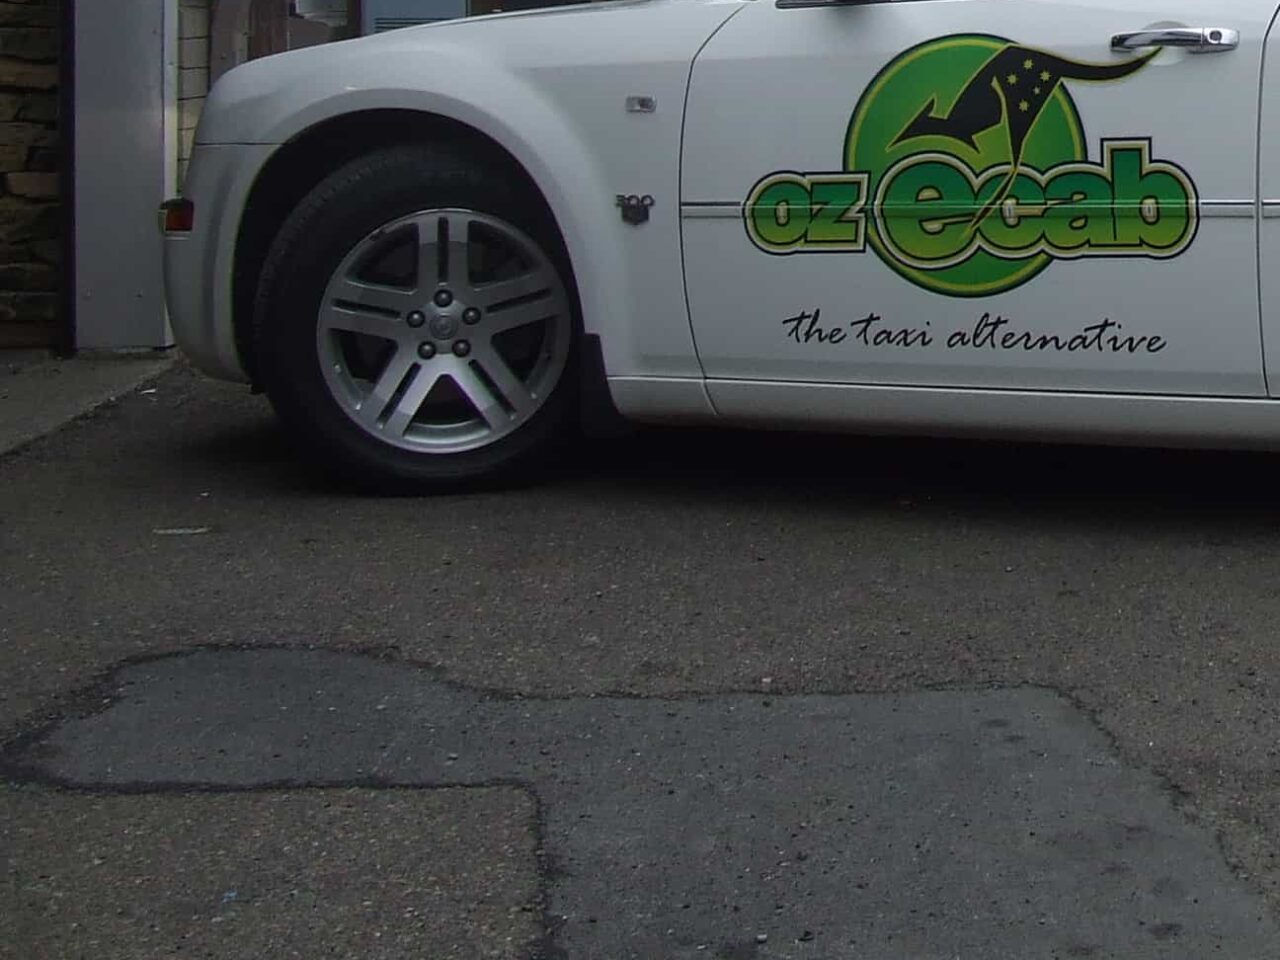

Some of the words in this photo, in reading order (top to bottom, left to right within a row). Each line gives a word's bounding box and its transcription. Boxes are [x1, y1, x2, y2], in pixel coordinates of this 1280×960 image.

[782, 308, 847, 344] the
[850, 312, 933, 347] taxi
[947, 312, 1168, 353] alternative
